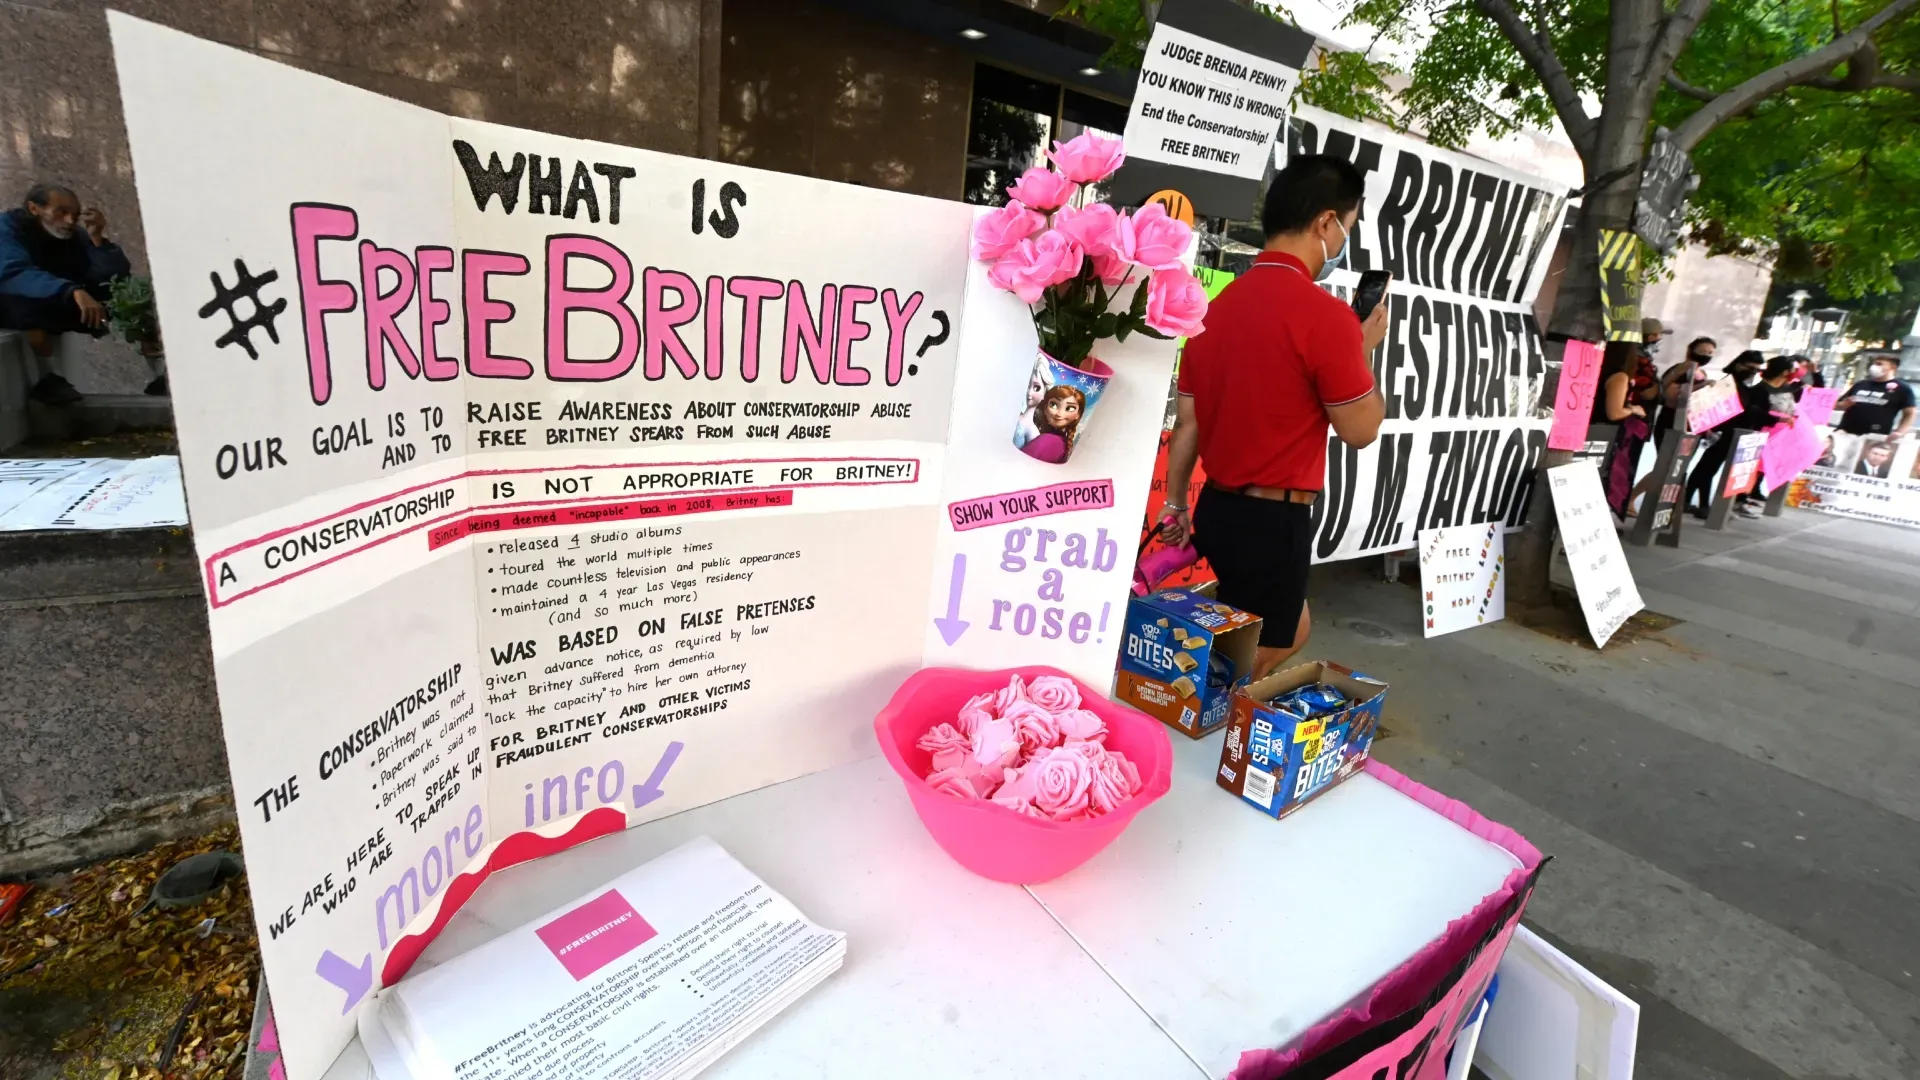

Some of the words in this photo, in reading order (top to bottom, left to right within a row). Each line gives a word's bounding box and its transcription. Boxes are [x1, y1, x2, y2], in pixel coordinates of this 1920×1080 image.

[1161, 41, 1203, 66] JUDGE
[1203, 54, 1248, 80] BRENDA
[1249, 69, 1287, 92] PENNY!
[1141, 69, 1168, 88] YOU
[1169, 77, 1206, 99] KNOW
[1207, 88, 1232, 106] THIS
[1233, 95, 1245, 109] IS
[1246, 99, 1285, 121] WRONG!
[1141, 102, 1164, 120] End
[1166, 108, 1184, 125] the
[1187, 114, 1269, 145] Conservatorship!
[1161, 138, 1191, 156] FREE
[1192, 144, 1240, 165] BRITNEY!
[453, 139, 636, 225] WHAT
[692, 178, 746, 238] IS
[216, 438, 287, 479] OUR
[312, 417, 373, 455] GOAL
[388, 412, 405, 437] IS
[421, 406, 443, 429] TO
[467, 402, 541, 423] RAISE
[559, 401, 672, 421] AWARENESS
[684, 401, 736, 419] ABOUT
[744, 402, 860, 418] CONSERVATORSHIP
[871, 403, 912, 418] ABUSE
[382, 443, 416, 469] AND
[431, 434, 451, 454] TO
[478, 429, 526, 448] FREE
[546, 427, 619, 444] BRITNEY
[630, 426, 684, 441] SPEARS
[698, 425, 734, 438] FROM
[746, 425, 779, 438] SUCH
[787, 425, 831, 439] ABUSE
[954, 502, 993, 525] SHOW
[1000, 494, 1040, 515] YOUR
[1045, 485, 1108, 509] SUPPORT
[1413, 428, 1547, 541] TAYLOR
[219, 562, 237, 586] A
[264, 488, 454, 569] CONSERVATORSHIP
[492, 481, 515, 499] IS
[545, 476, 593, 494] NOT
[623, 470, 753, 490] APPROPRIATE
[781, 468, 812, 481] FOR
[836, 464, 911, 480] BRITNEY!
[435, 525, 459, 545] Since
[468, 518, 500, 532] being
[512, 512, 556, 526] deemed
[640, 504, 661, 515] back
[668, 503, 676, 512] in
[726, 495, 759, 507] Britney
[499, 536, 558, 553] released
[570, 534, 580, 547] 4
[590, 531, 628, 544] studio
[636, 526, 682, 538] albums
[499, 559, 544, 576] toured
[557, 556, 576, 568] the
[585, 551, 617, 565] world
[627, 546, 672, 560] multiple
[683, 542, 713, 552] times
[1000, 527, 1118, 572] grab
[1446, 548, 1470, 558] FREE
[1038, 568, 1064, 602] a
[989, 599, 1111, 644] rose!
[1127, 633, 1173, 670] BITES
[254, 775, 300, 823] THE
[319, 662, 461, 780] CONSERVATORSHIP
[490, 640, 537, 666] WAS
[559, 626, 618, 652] BASED
[638, 618, 665, 637] ON
[680, 609, 723, 630] FALSE
[736, 595, 815, 621] PRETENSES
[377, 727, 417, 764] Britney
[421, 710, 440, 729] was
[450, 689, 466, 709] not
[485, 671, 527, 690] given
[545, 657, 594, 674] advance
[606, 648, 643, 662] notice,
[649, 644, 663, 654] as
[675, 632, 721, 650] required
[730, 629, 741, 642] by
[751, 625, 769, 635] law
[382, 772, 416, 807] Britney
[422, 755, 440, 774] was
[447, 736, 463, 755] said
[467, 725, 477, 737] to
[526, 704, 546, 716] the
[609, 687, 622, 697] to
[627, 681, 647, 693] hire
[655, 676, 672, 688] her
[679, 672, 699, 683] own
[706, 663, 747, 677] attorney
[1252, 719, 1273, 765] BITES
[1293, 743, 1349, 799] BITES
[269, 905, 296, 940] WE
[301, 873, 334, 915] ARE
[346, 827, 385, 872] HERE
[395, 803, 413, 825] TO
[425, 763, 460, 801] SPEAK
[467, 747, 480, 765] UP
[490, 731, 524, 751] FOR
[536, 711, 606, 740] BRITNEY
[619, 703, 646, 718] AND
[659, 691, 699, 708] OTHER
[705, 679, 751, 698] VICTIMS
[322, 876, 357, 915] WHO
[369, 842, 393, 874] ARE
[410, 782, 461, 834] TRAPPED
[472, 762, 482, 780] IN
[496, 731, 592, 768] FRAUDULENT
[603, 699, 728, 738] CONSERVATORSHIPS
[375, 804, 484, 951] more
[525, 759, 625, 827] info
[559, 911, 633, 956] #FREEBRITNEY
[455, 1028, 527, 1074] #FreeBritney
[540, 991, 591, 1023] advocating
[592, 982, 605, 992] for
[606, 963, 637, 984] Britney
[638, 943, 672, 964] Spears's
[673, 924, 700, 944] release
[701, 914, 715, 926] and
[715, 895, 745, 916] freedom
[744, 884, 762, 897] from
